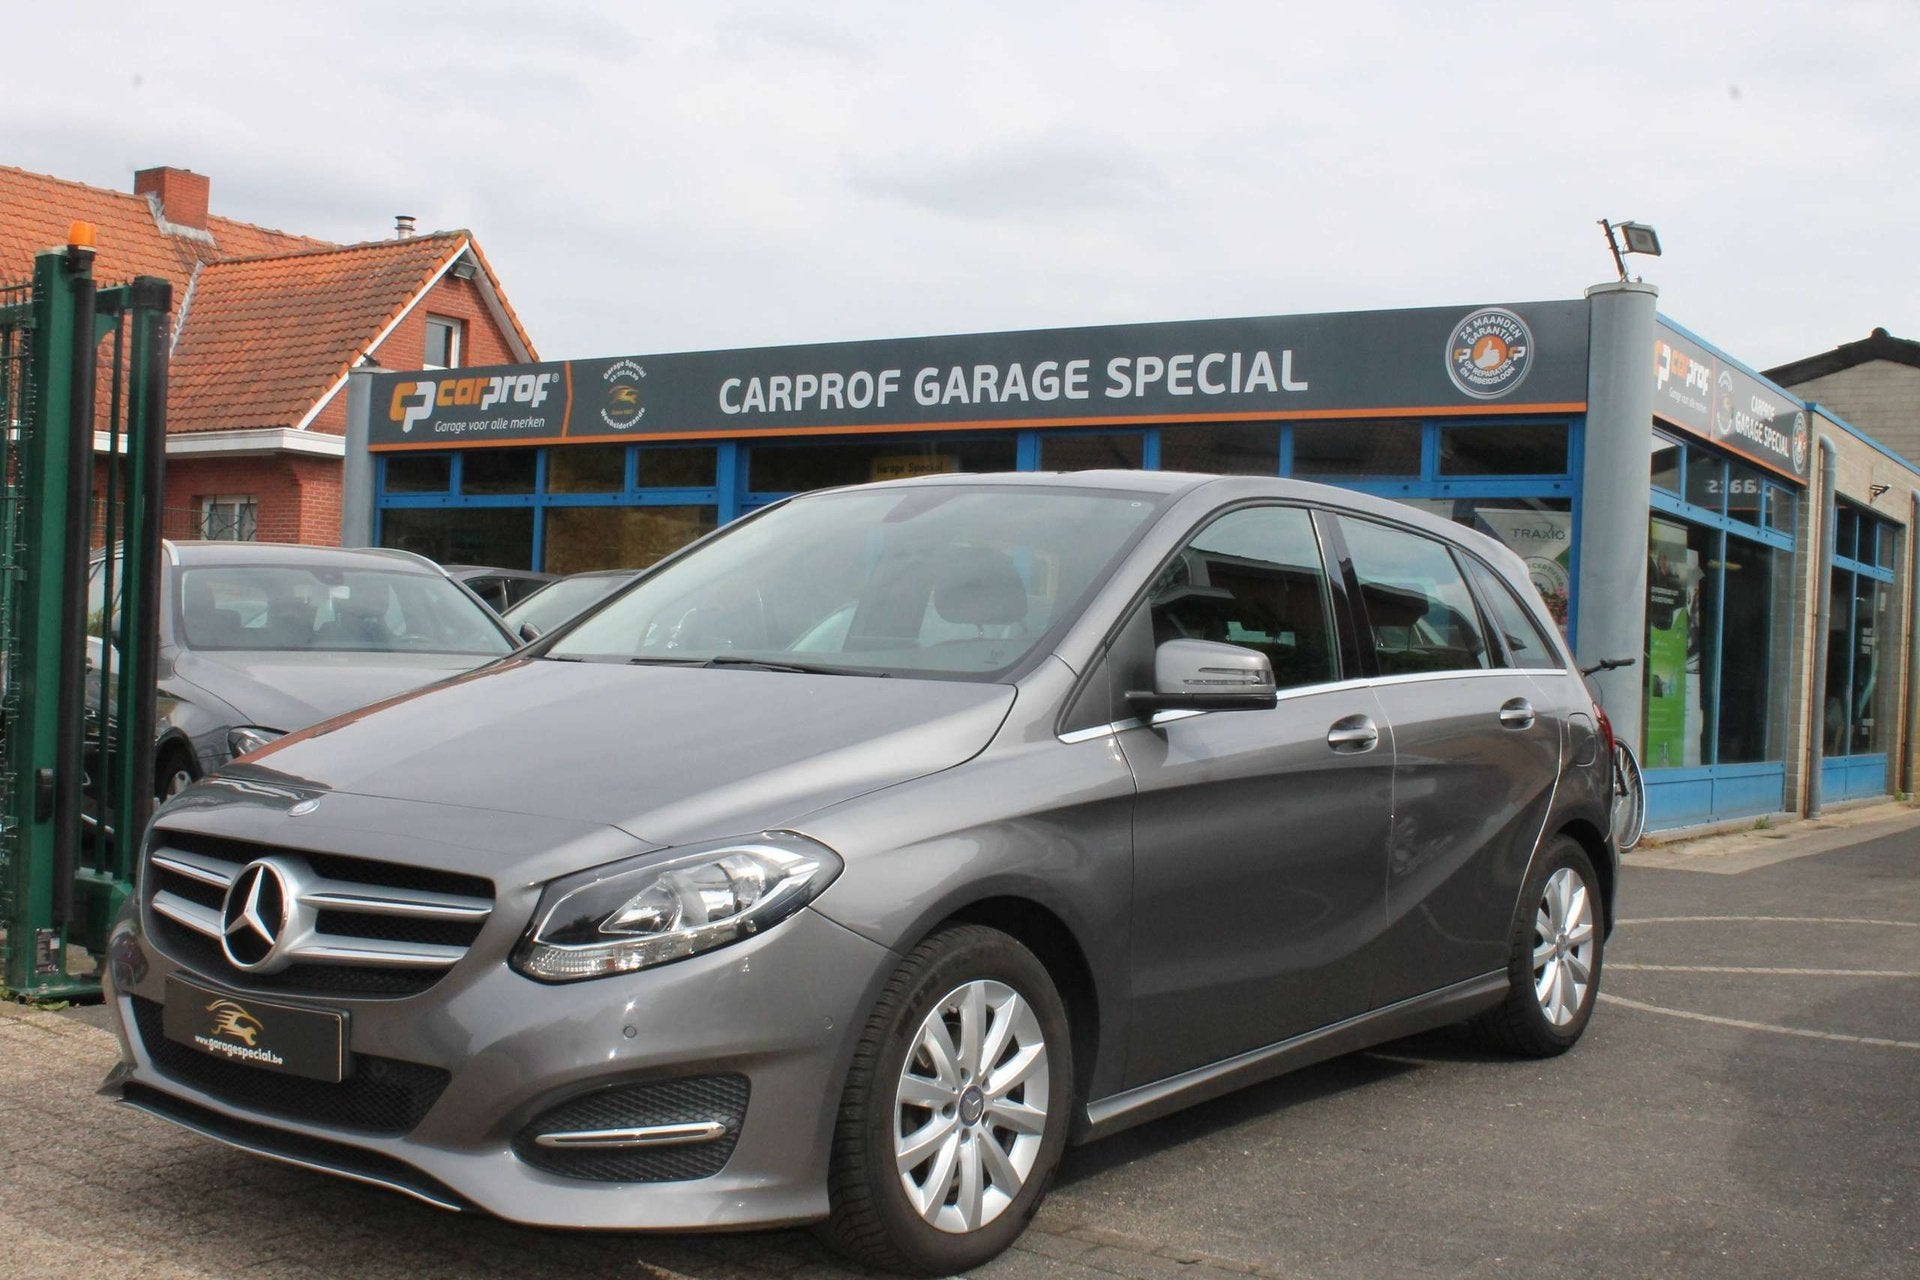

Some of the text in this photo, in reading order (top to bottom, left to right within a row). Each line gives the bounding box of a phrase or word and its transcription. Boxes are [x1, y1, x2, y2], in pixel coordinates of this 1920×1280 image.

[1460, 315, 1522, 339] 24 MAANDEN
[1467, 326, 1514, 344] GARANTIE
[603, 359, 647, 380] Garage Special
[718, 350, 1309, 415] CARPROF GARAGE SPECIAL
[435, 416, 545, 434] Garage voor alle merken
[1736, 411, 1763, 444] GARAGE
[1764, 426, 1789, 457] SPECIAL
[1511, 528, 1566, 541] TRAXIO
[195, 1034, 283, 1065] www.garagespecial.be
